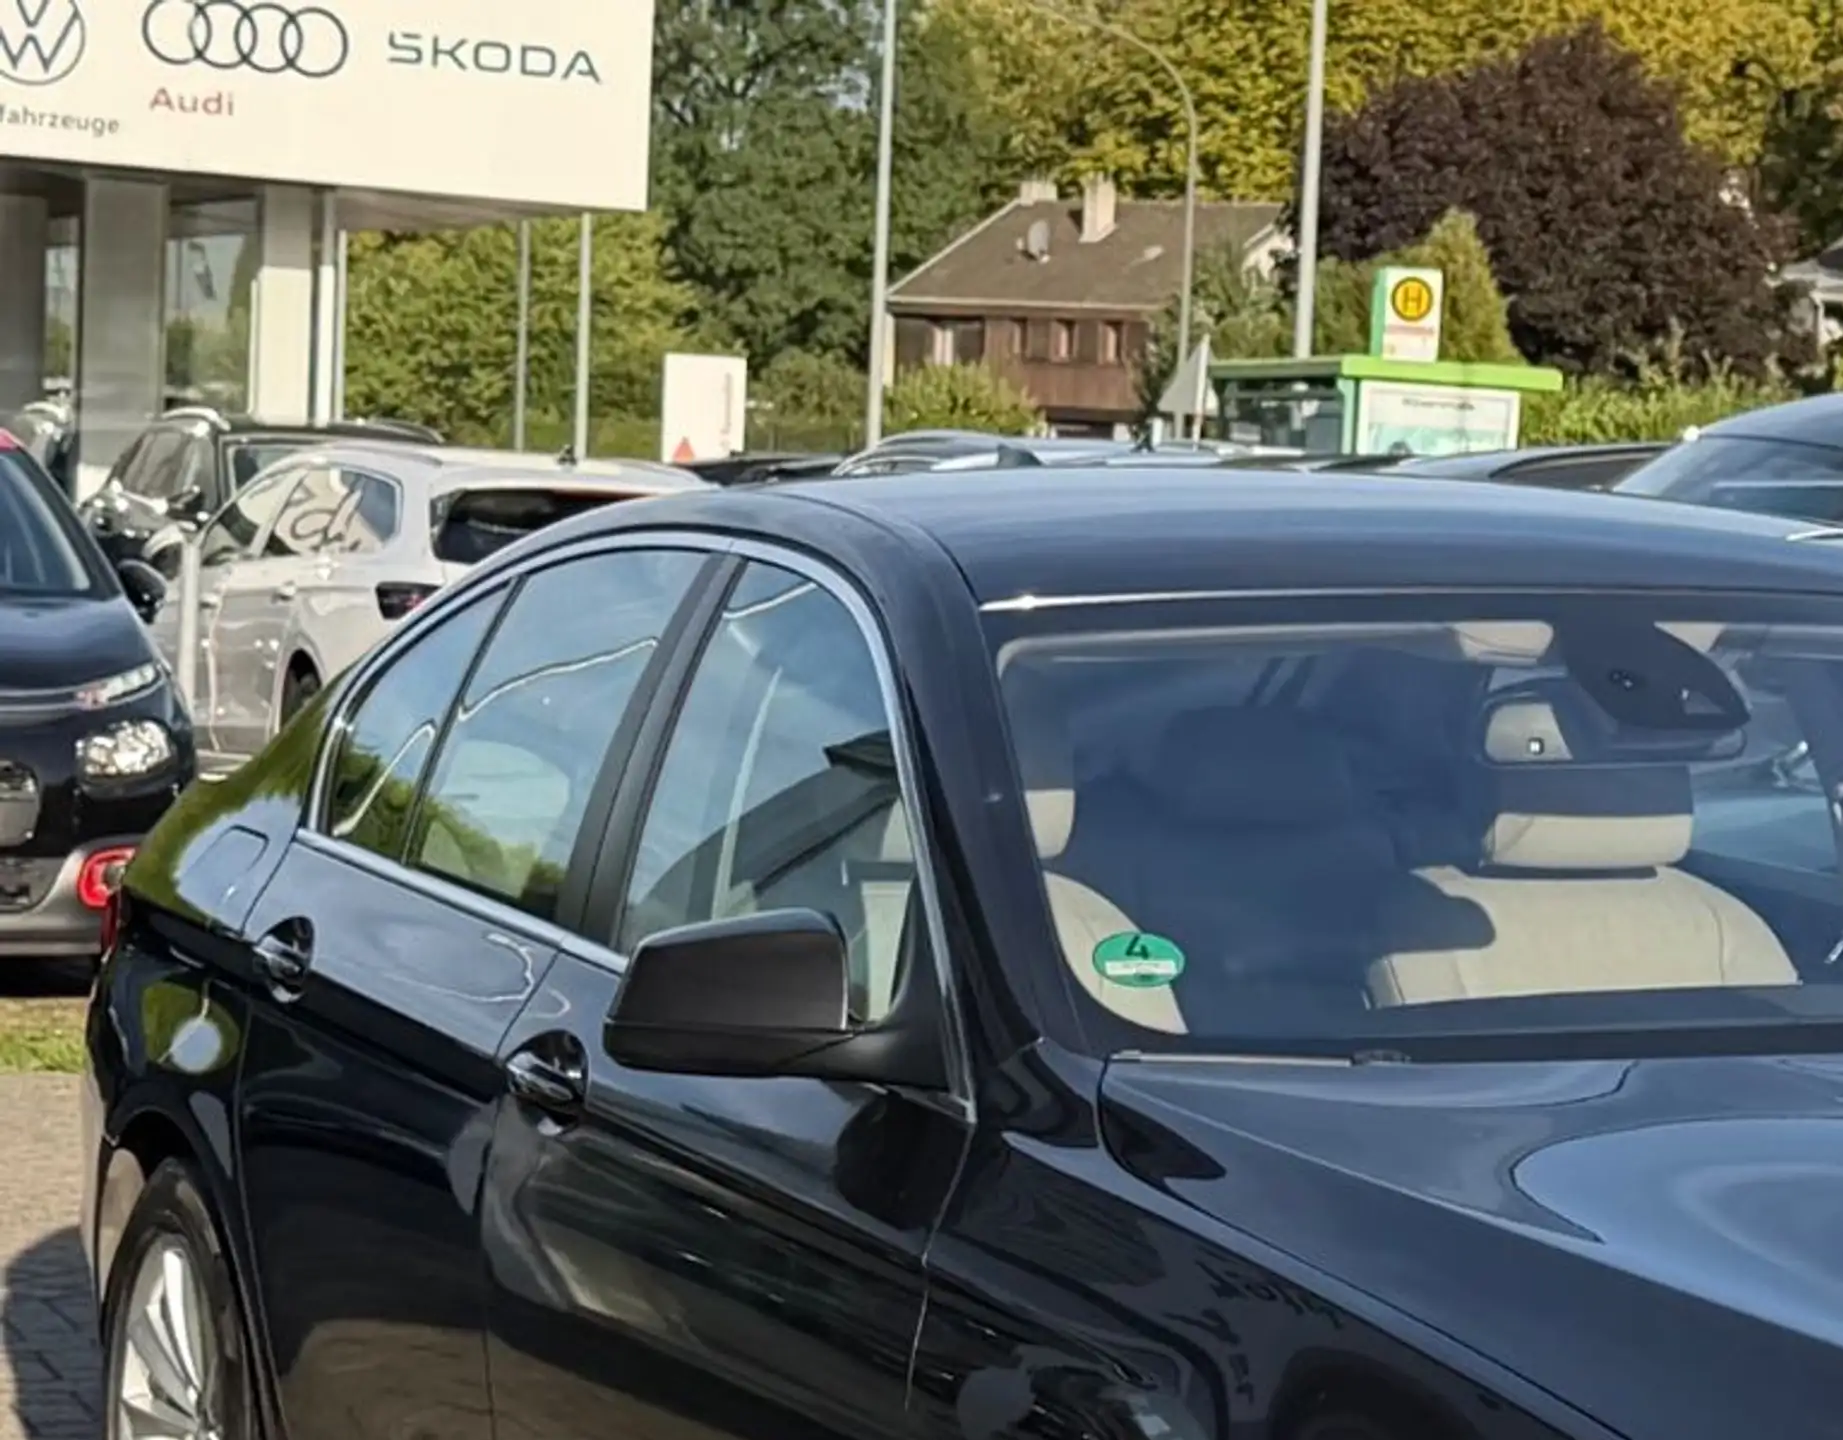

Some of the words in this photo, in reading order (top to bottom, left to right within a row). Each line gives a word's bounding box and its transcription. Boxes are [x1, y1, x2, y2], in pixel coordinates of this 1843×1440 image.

[149, 86, 234, 117] Audi
[1403, 286, 1423, 313] H
[1125, 933, 1150, 960] 4
